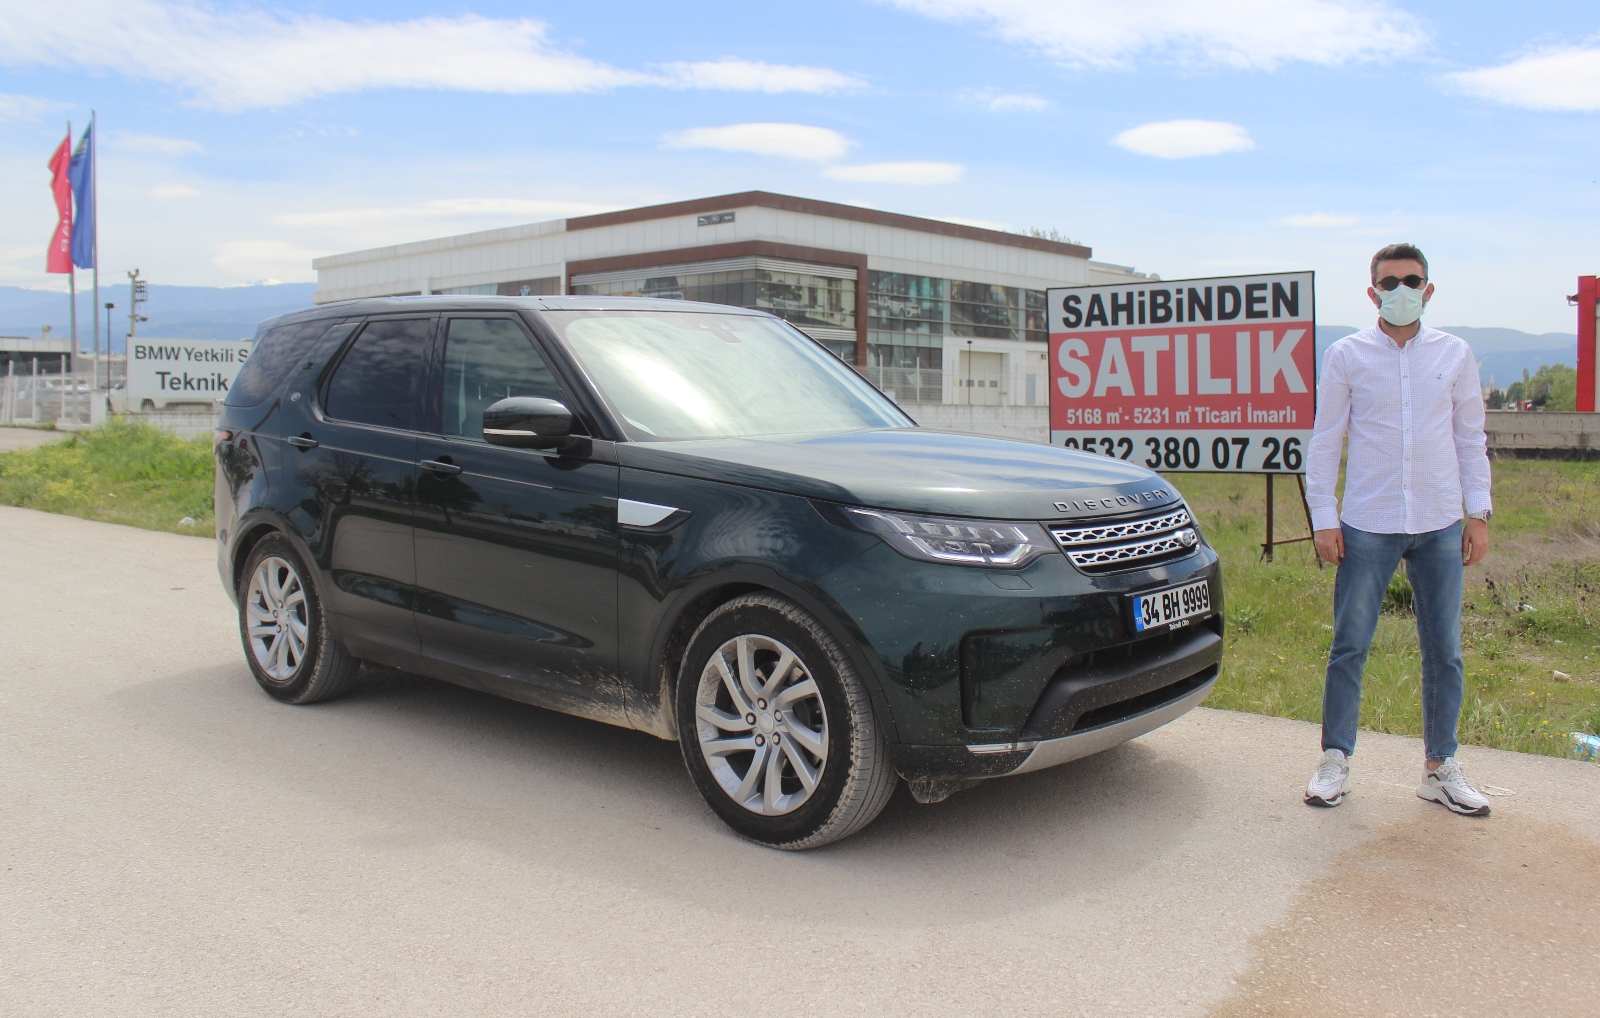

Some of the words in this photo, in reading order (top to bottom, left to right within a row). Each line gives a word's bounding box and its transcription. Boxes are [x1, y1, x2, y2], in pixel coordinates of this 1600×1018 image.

[134, 345, 181, 361] BMW
[183, 347, 234, 363] Yetkili
[1057, 329, 1308, 399] SATILIK
[155, 371, 229, 391] Teknik
[1067, 408, 1102, 425] 5168
[1133, 406, 1170, 424] 5231
[1195, 406, 1242, 424] Ticari
[1247, 402, 1297, 424] İmarlı
[1145, 437, 1200, 469] 380
[1212, 437, 1250, 469] 07
[1262, 437, 1302, 470] 26
[1053, 488, 1170, 512] DISCOVERY
[1142, 597, 1159, 625] 34
[1162, 591, 1180, 620] BH
[1182, 584, 1208, 614] 9999
